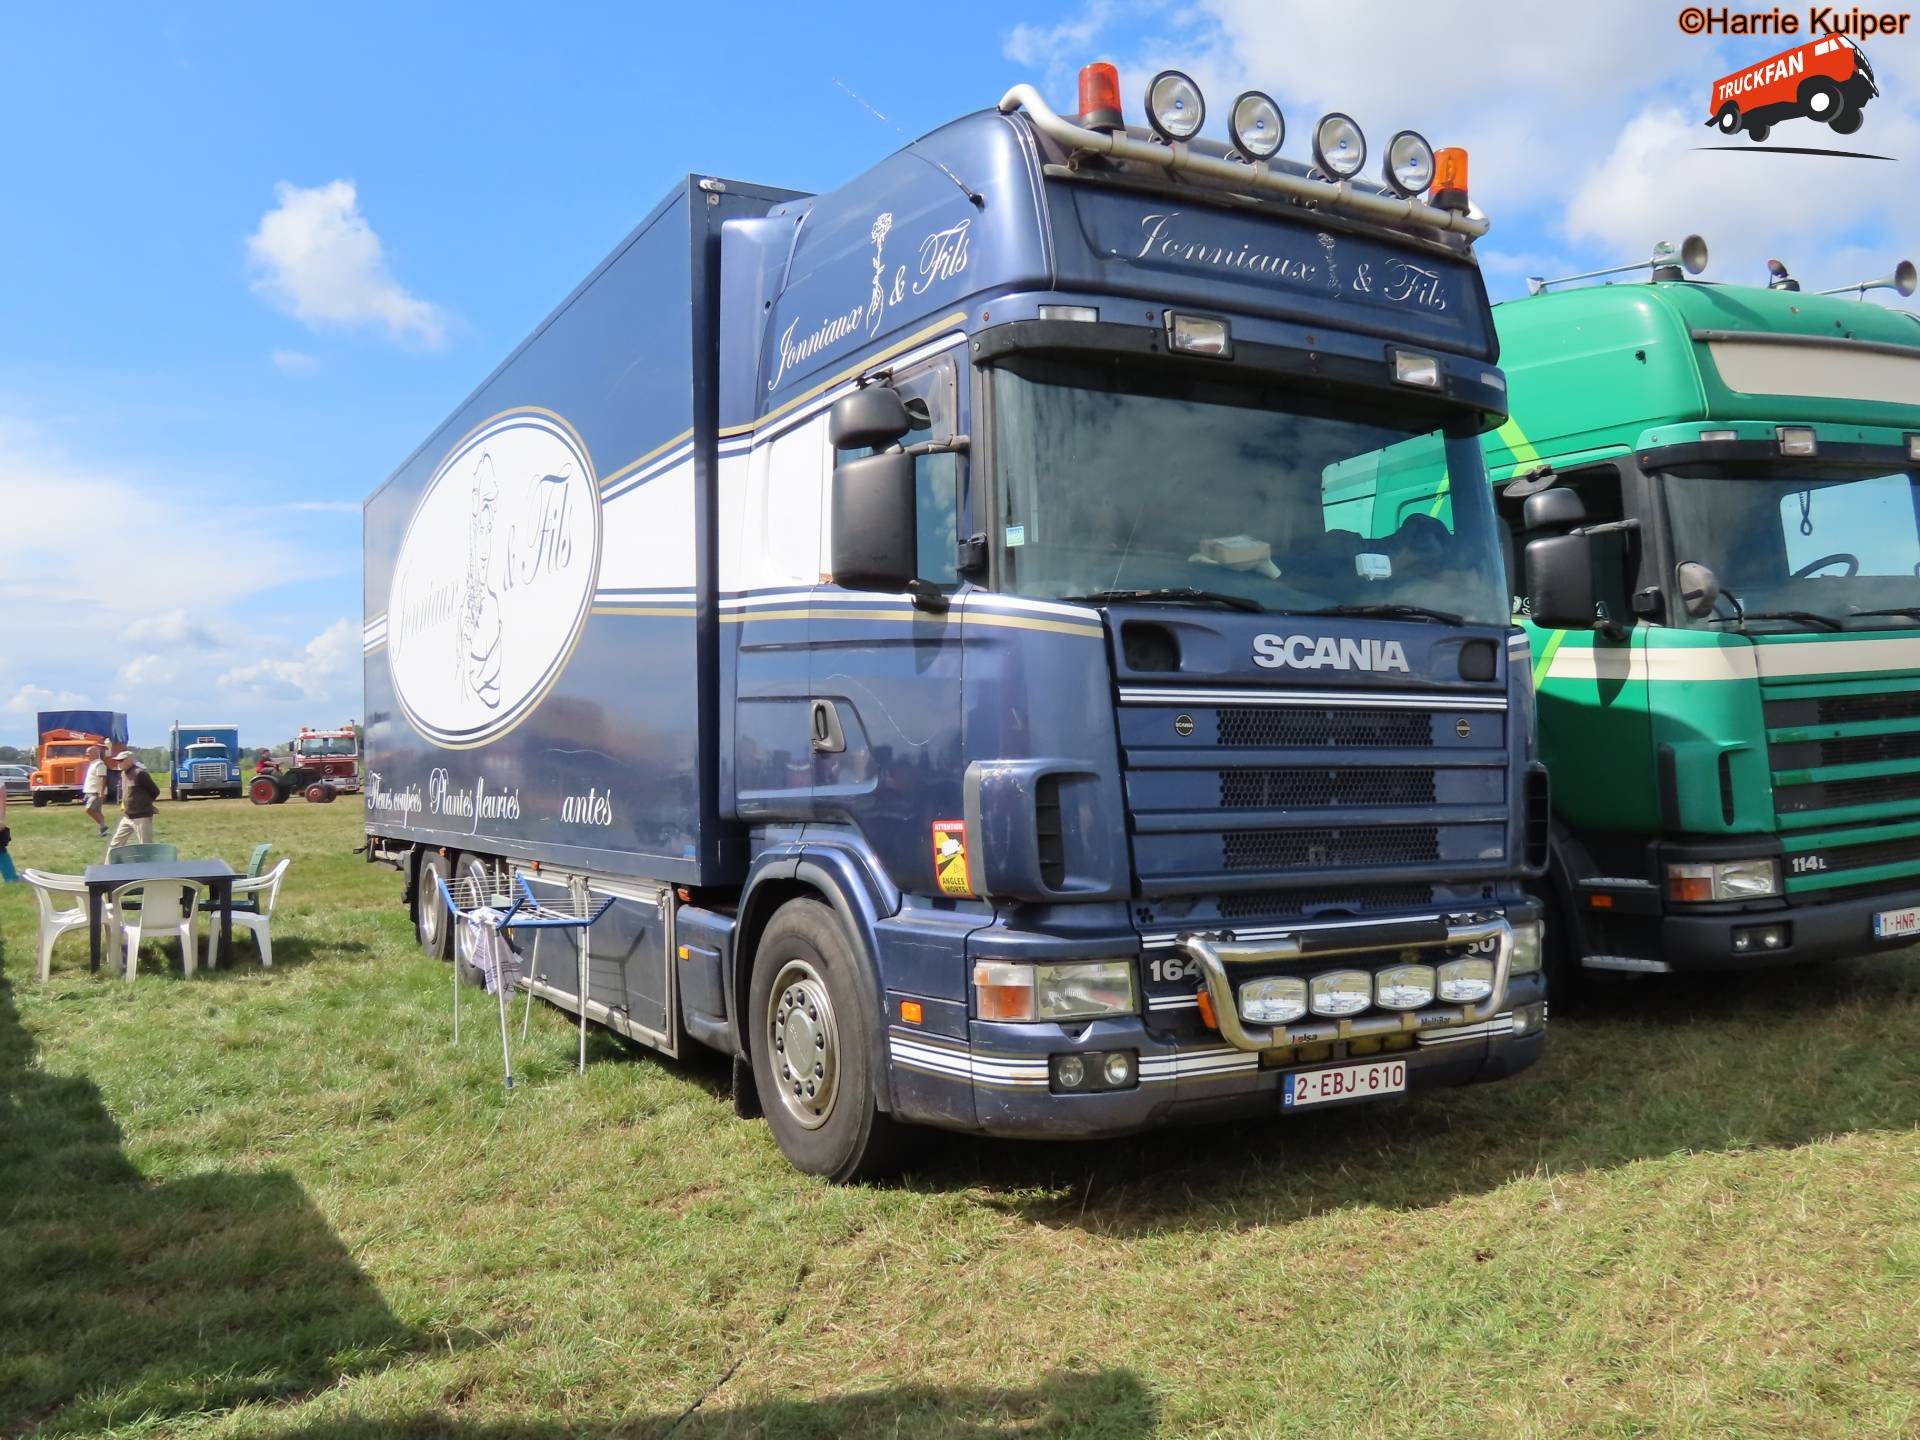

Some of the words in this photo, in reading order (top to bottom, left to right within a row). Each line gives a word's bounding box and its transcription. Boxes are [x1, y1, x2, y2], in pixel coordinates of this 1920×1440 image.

[767, 315, 863, 391] Jonniaux
[889, 265, 906, 307] &
[912, 218, 971, 295] Fils
[1353, 263, 1373, 294] &
[1384, 257, 1447, 312] Fils
[520, 462, 573, 586] Fils
[1252, 633, 1410, 673] SCANIA
[429, 767, 473, 818] Plantes
[464, 775, 520, 836] fleuries
[560, 787, 613, 826] antes
[942, 877, 965, 885] ANGLES
[1150, 958, 1201, 982] 164
[1284, 1093, 1292, 1104] B
